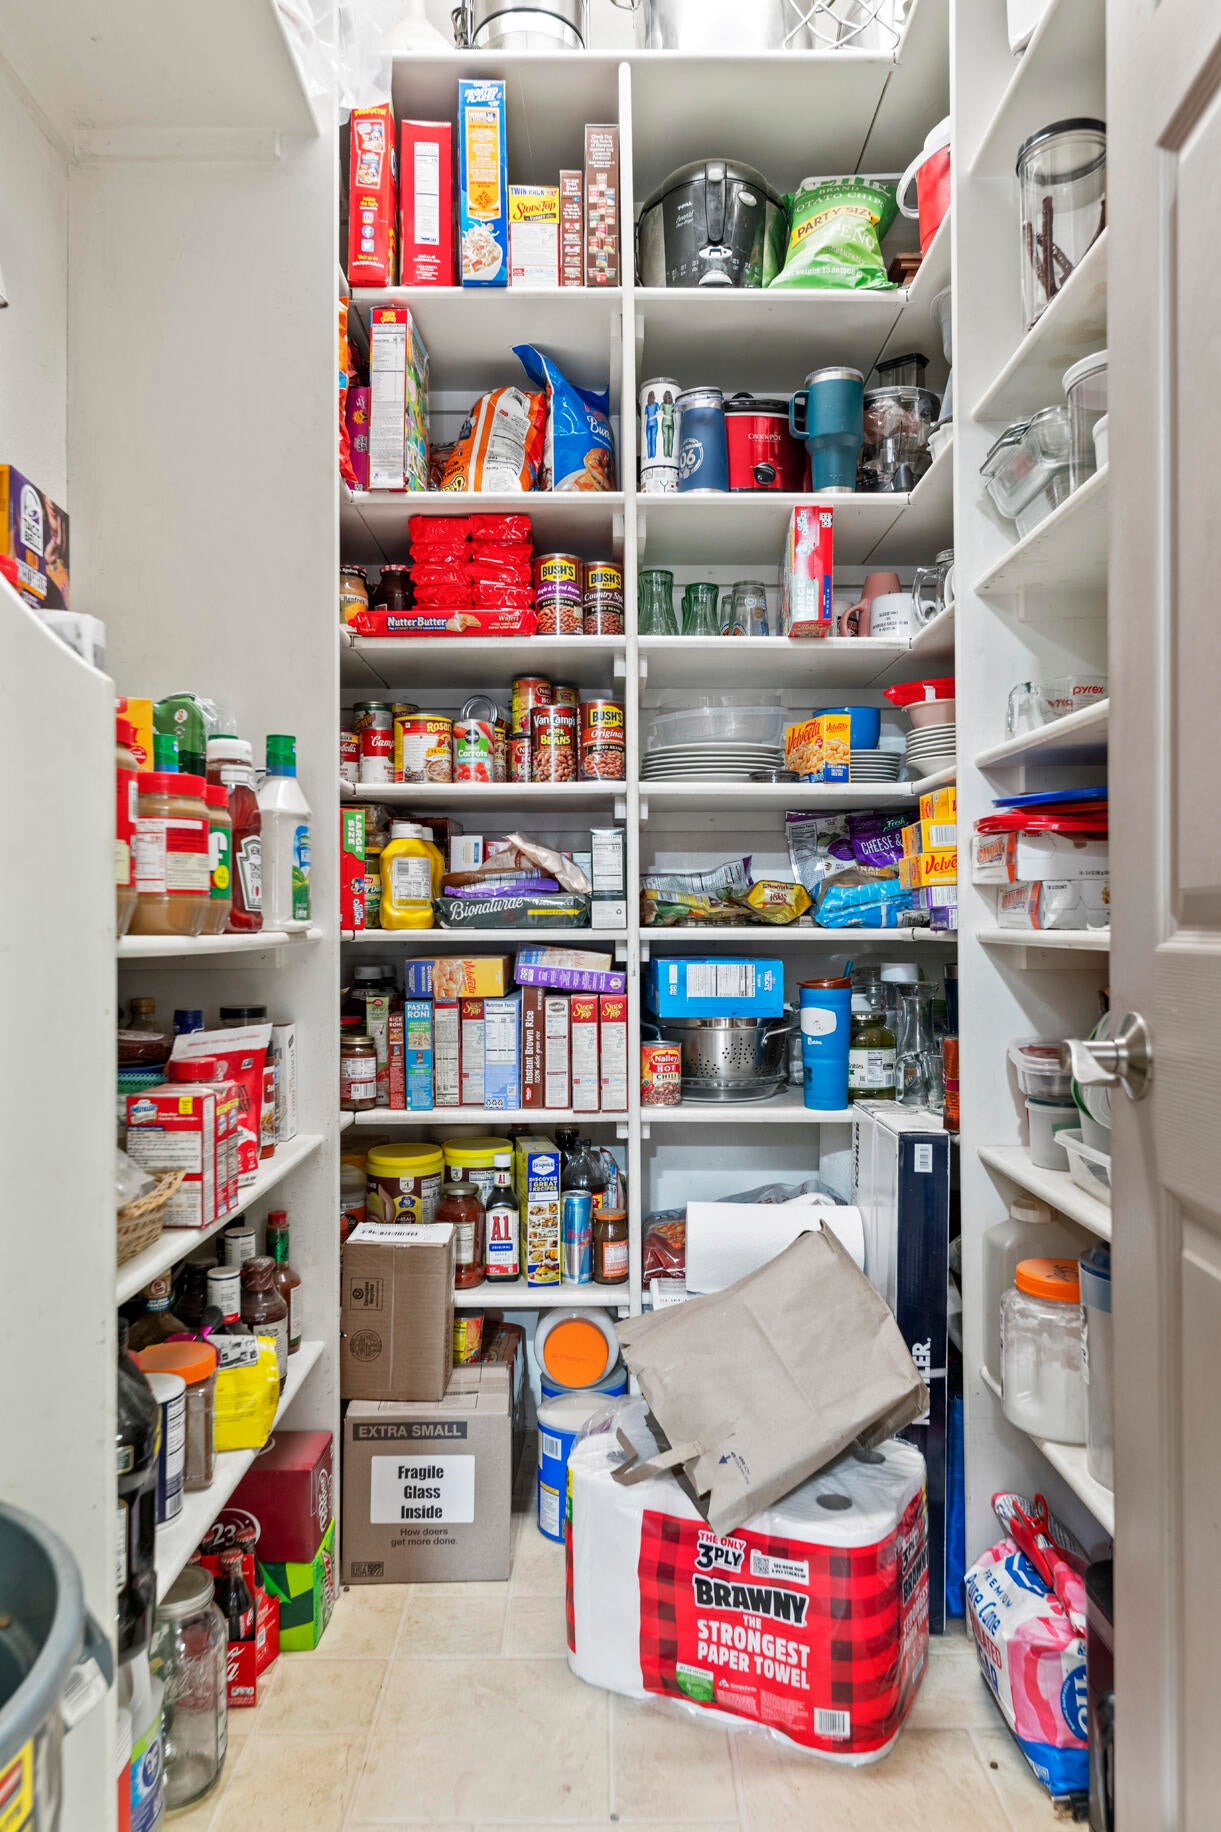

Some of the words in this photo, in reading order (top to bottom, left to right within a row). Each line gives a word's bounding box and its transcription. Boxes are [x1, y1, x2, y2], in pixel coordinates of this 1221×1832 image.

[511, 187, 527, 196] TWIN
[819, 185, 860, 195] BRAND
[797, 206, 842, 238] PARTY
[542, 564, 574, 578] BUSH'S
[591, 573, 621, 587] BUSH'S
[584, 591, 613, 602] Country
[387, 616, 417, 627] Nutter
[417, 616, 448, 627] Butter
[1072, 685, 1105, 696] pyrex
[533, 714, 549, 726] Van
[552, 713, 576, 727] Camp's
[592, 711, 623, 723] BUSH'S
[546, 727, 565, 735] PORK
[590, 729, 624, 740] Original
[540, 734, 571, 745] BEANS
[458, 751, 488, 759] Carrots
[887, 818, 908, 828] Fresh
[347, 819, 355, 846] SIZE
[355, 814, 363, 853] LARGE
[861, 834, 895, 855] CHEESE
[895, 833, 903, 845] &
[925, 854, 957, 875] Velve
[407, 1011, 430, 1019] RONI
[525, 1010, 534, 1027] Rice
[525, 1029, 534, 1055] Brown
[654, 1055, 678, 1063] Nalley
[525, 1057, 534, 1085] Instant
[657, 1065, 676, 1073] HOT
[358, 1425, 408, 1438] EXTRA
[411, 1424, 462, 1437] SMALL
[397, 1465, 445, 1481] Fragile
[403, 1485, 441, 1500] Glass
[400, 1505, 443, 1519] Inside
[400, 1528, 421, 1536] How
[422, 1527, 448, 1536] doers
[390, 1538, 406, 1548] get
[433, 1536, 458, 1546] done.
[699, 1531, 718, 1544] THE
[720, 1538, 745, 1551] ONLY
[694, 1577, 808, 1625] BRAWNY
[965, 1571, 984, 1610] Pure
[978, 1601, 1001, 1636] Cane
[742, 1614, 762, 1630] THE
[697, 1619, 811, 1668] STRONGEST
[697, 1640, 750, 1673] PAPER
[753, 1655, 811, 1690] TOWEL
